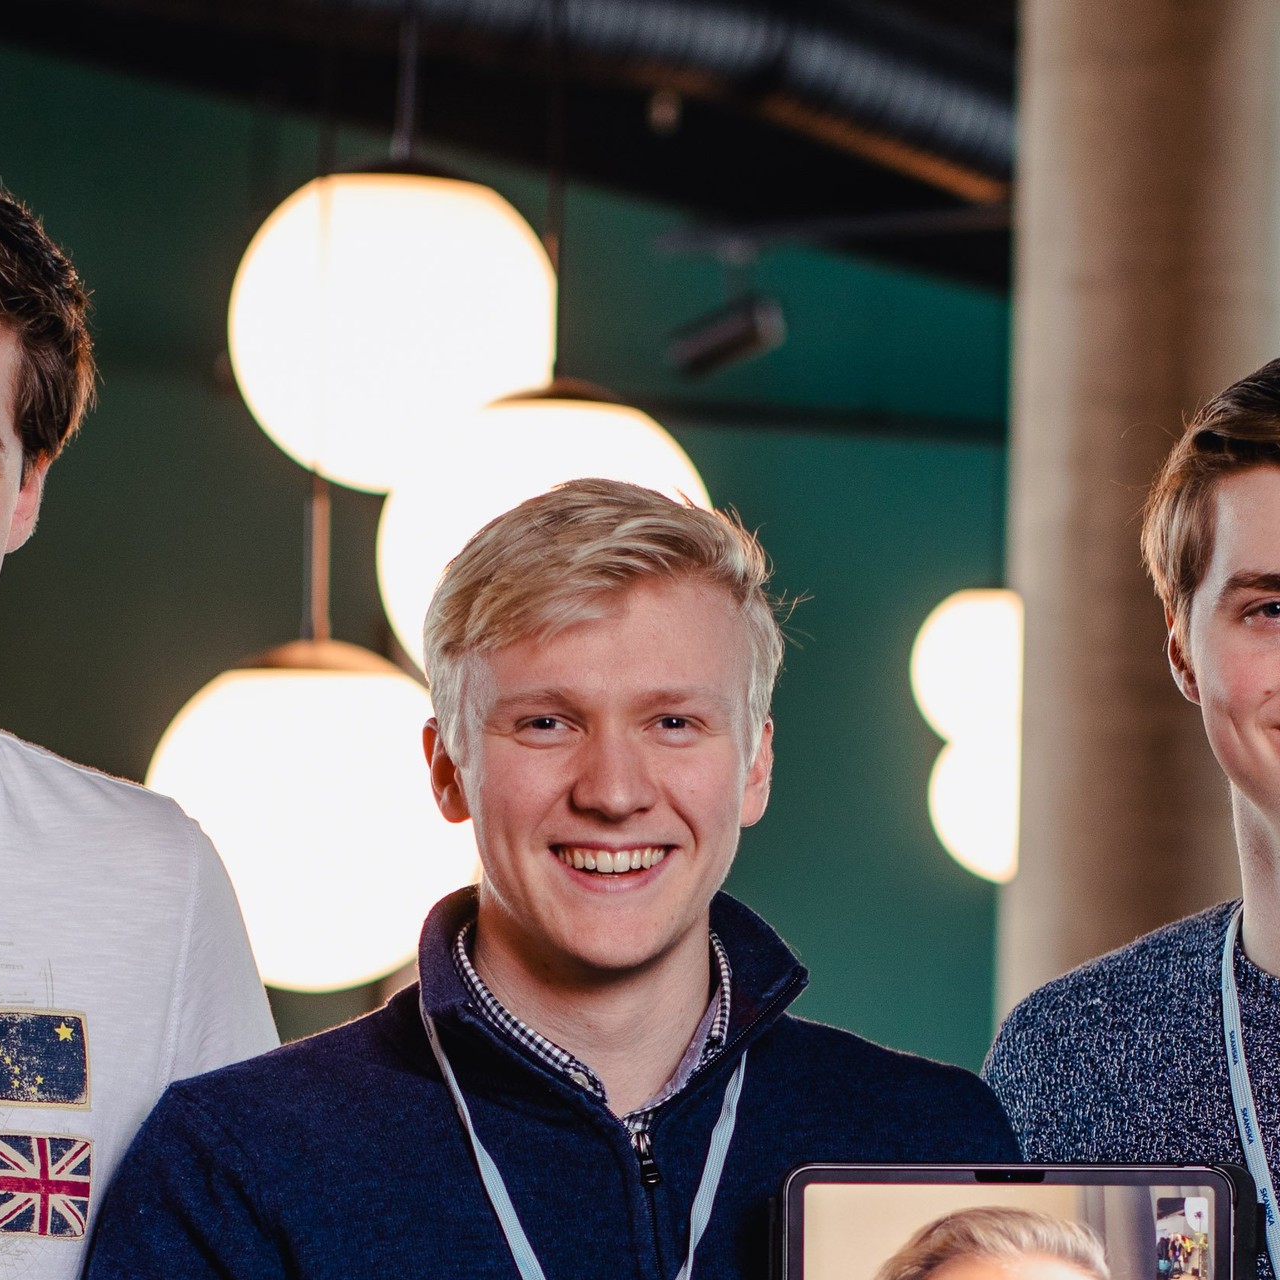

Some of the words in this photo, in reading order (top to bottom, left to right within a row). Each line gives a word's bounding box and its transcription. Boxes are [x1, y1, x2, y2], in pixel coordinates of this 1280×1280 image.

[1229, 1030, 1239, 1066] SKANSKA
[1241, 1107, 1254, 1145] SKANSKA
[1260, 1187, 1275, 1227] SKANSKA
